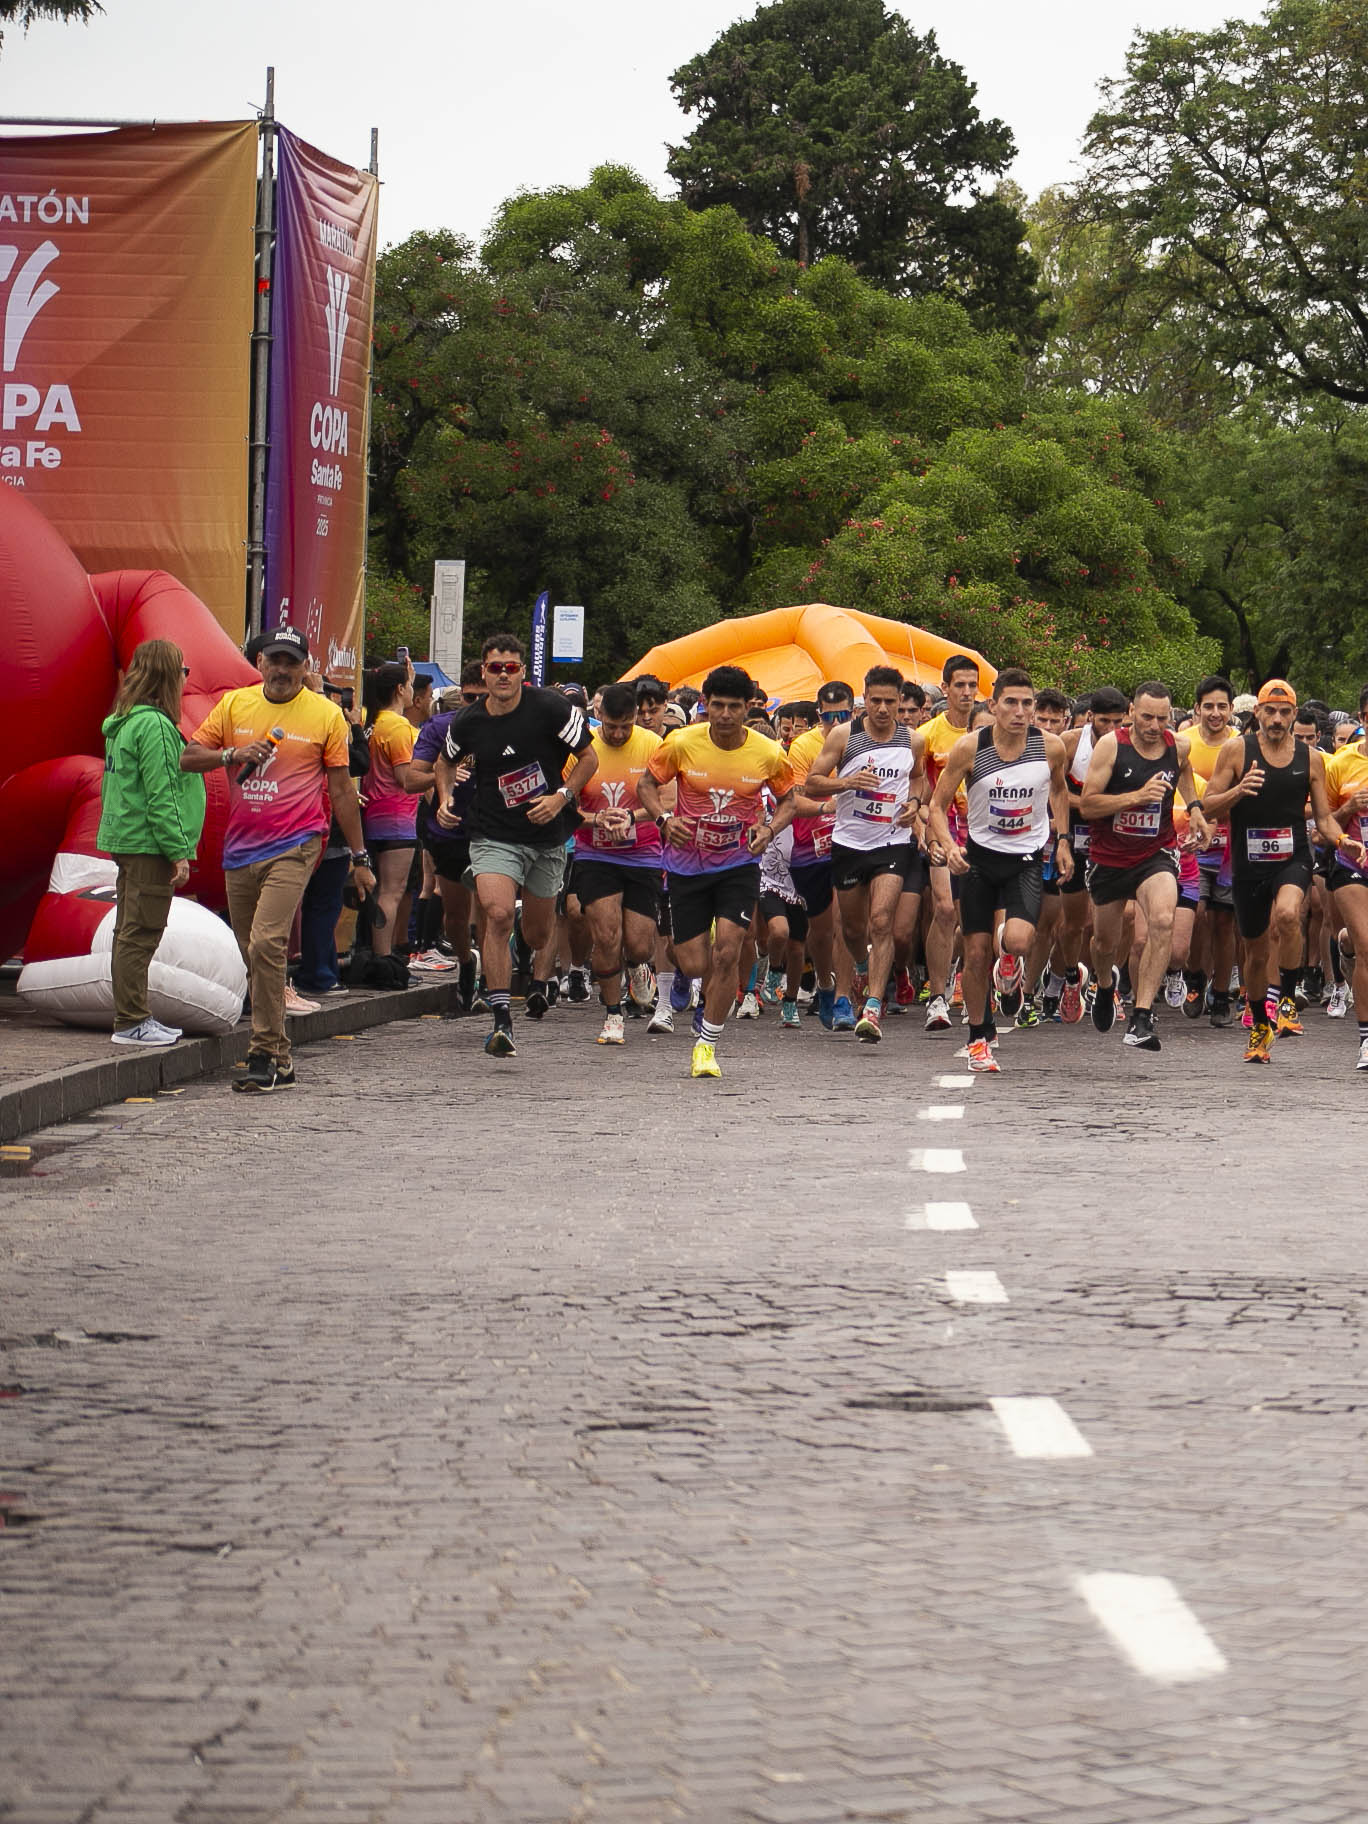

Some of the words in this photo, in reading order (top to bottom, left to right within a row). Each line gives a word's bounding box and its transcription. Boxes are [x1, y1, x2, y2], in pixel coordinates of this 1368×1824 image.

[3, 384, 82, 432] PA
[311, 402, 348, 456] COPA
[26, 441, 61, 468] Fe
[2, 475, 25, 486] CIA
[241, 779, 279, 794] COPA
[506, 773, 539, 797] 5377
[866, 802, 883, 815] 45
[998, 818, 1025, 829] 444
[1120, 812, 1154, 827] 5011
[702, 832, 736, 845] 5323
[1262, 841, 1280, 853] 96
